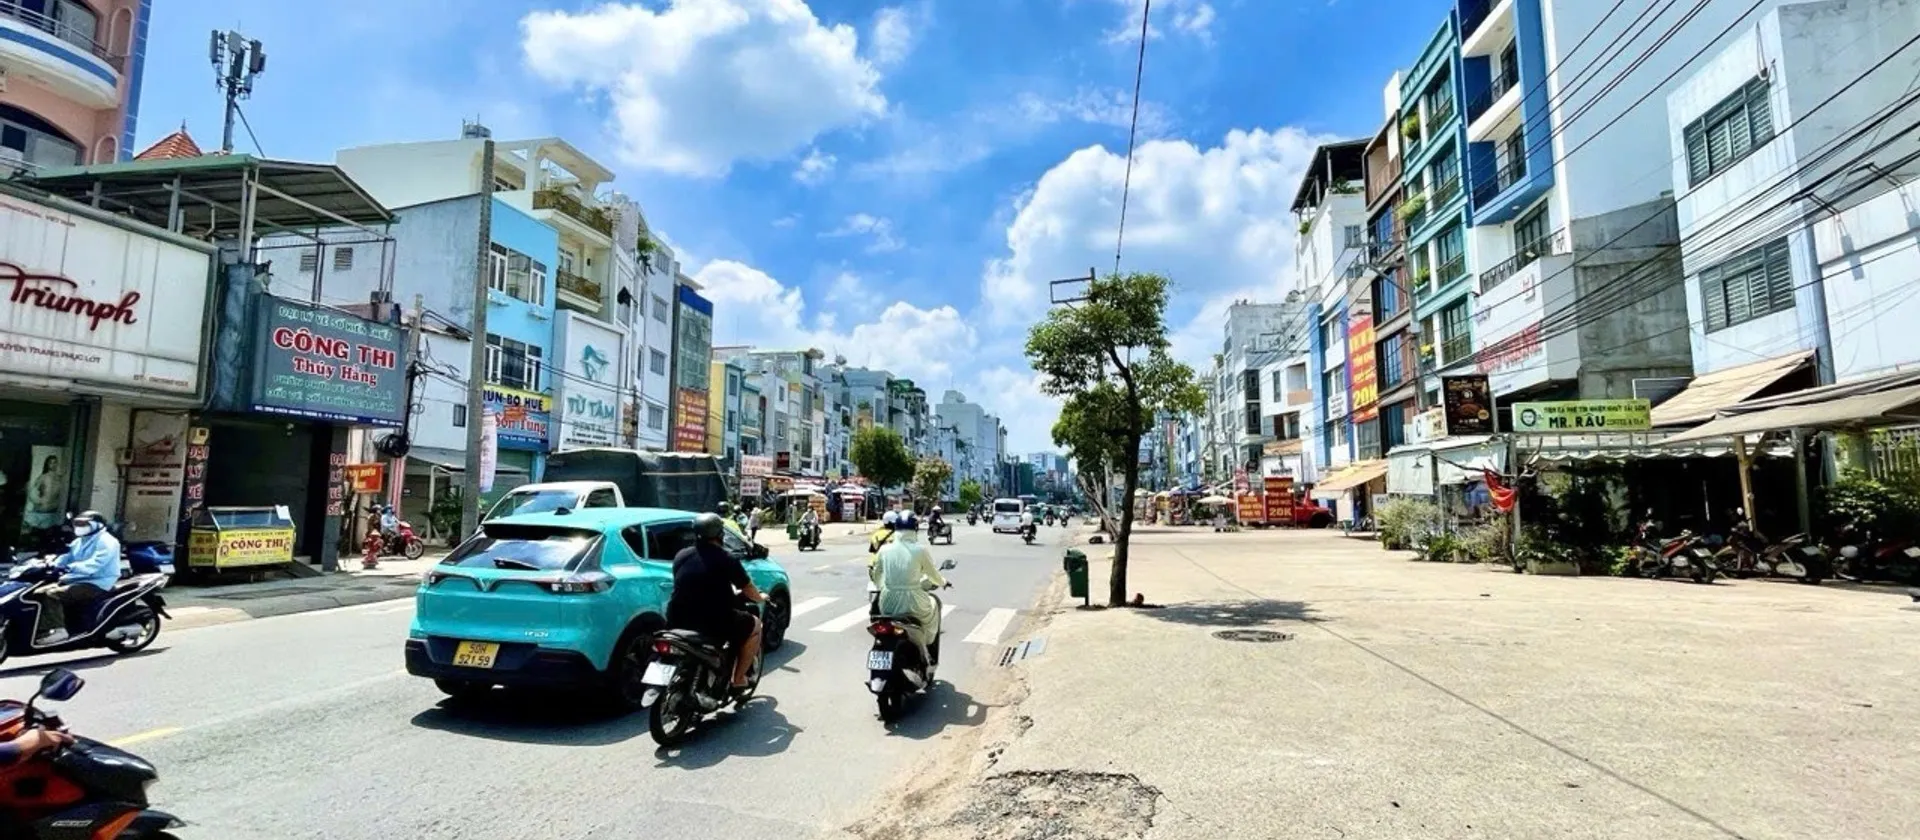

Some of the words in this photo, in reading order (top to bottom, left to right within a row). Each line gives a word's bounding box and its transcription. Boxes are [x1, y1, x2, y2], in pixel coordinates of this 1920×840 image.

[0, 262, 141, 331] Triumph
[273, 327, 349, 361] CÔNG
[357, 345, 397, 370] THI
[1353, 382, 1377, 407] 20K
[1549, 416, 1572, 428] MR.
[1575, 412, 1605, 427] RÂU
[1269, 507, 1292, 517] 20K
[231, 537, 262, 549] CÔNG
[266, 538, 284, 548] THI
